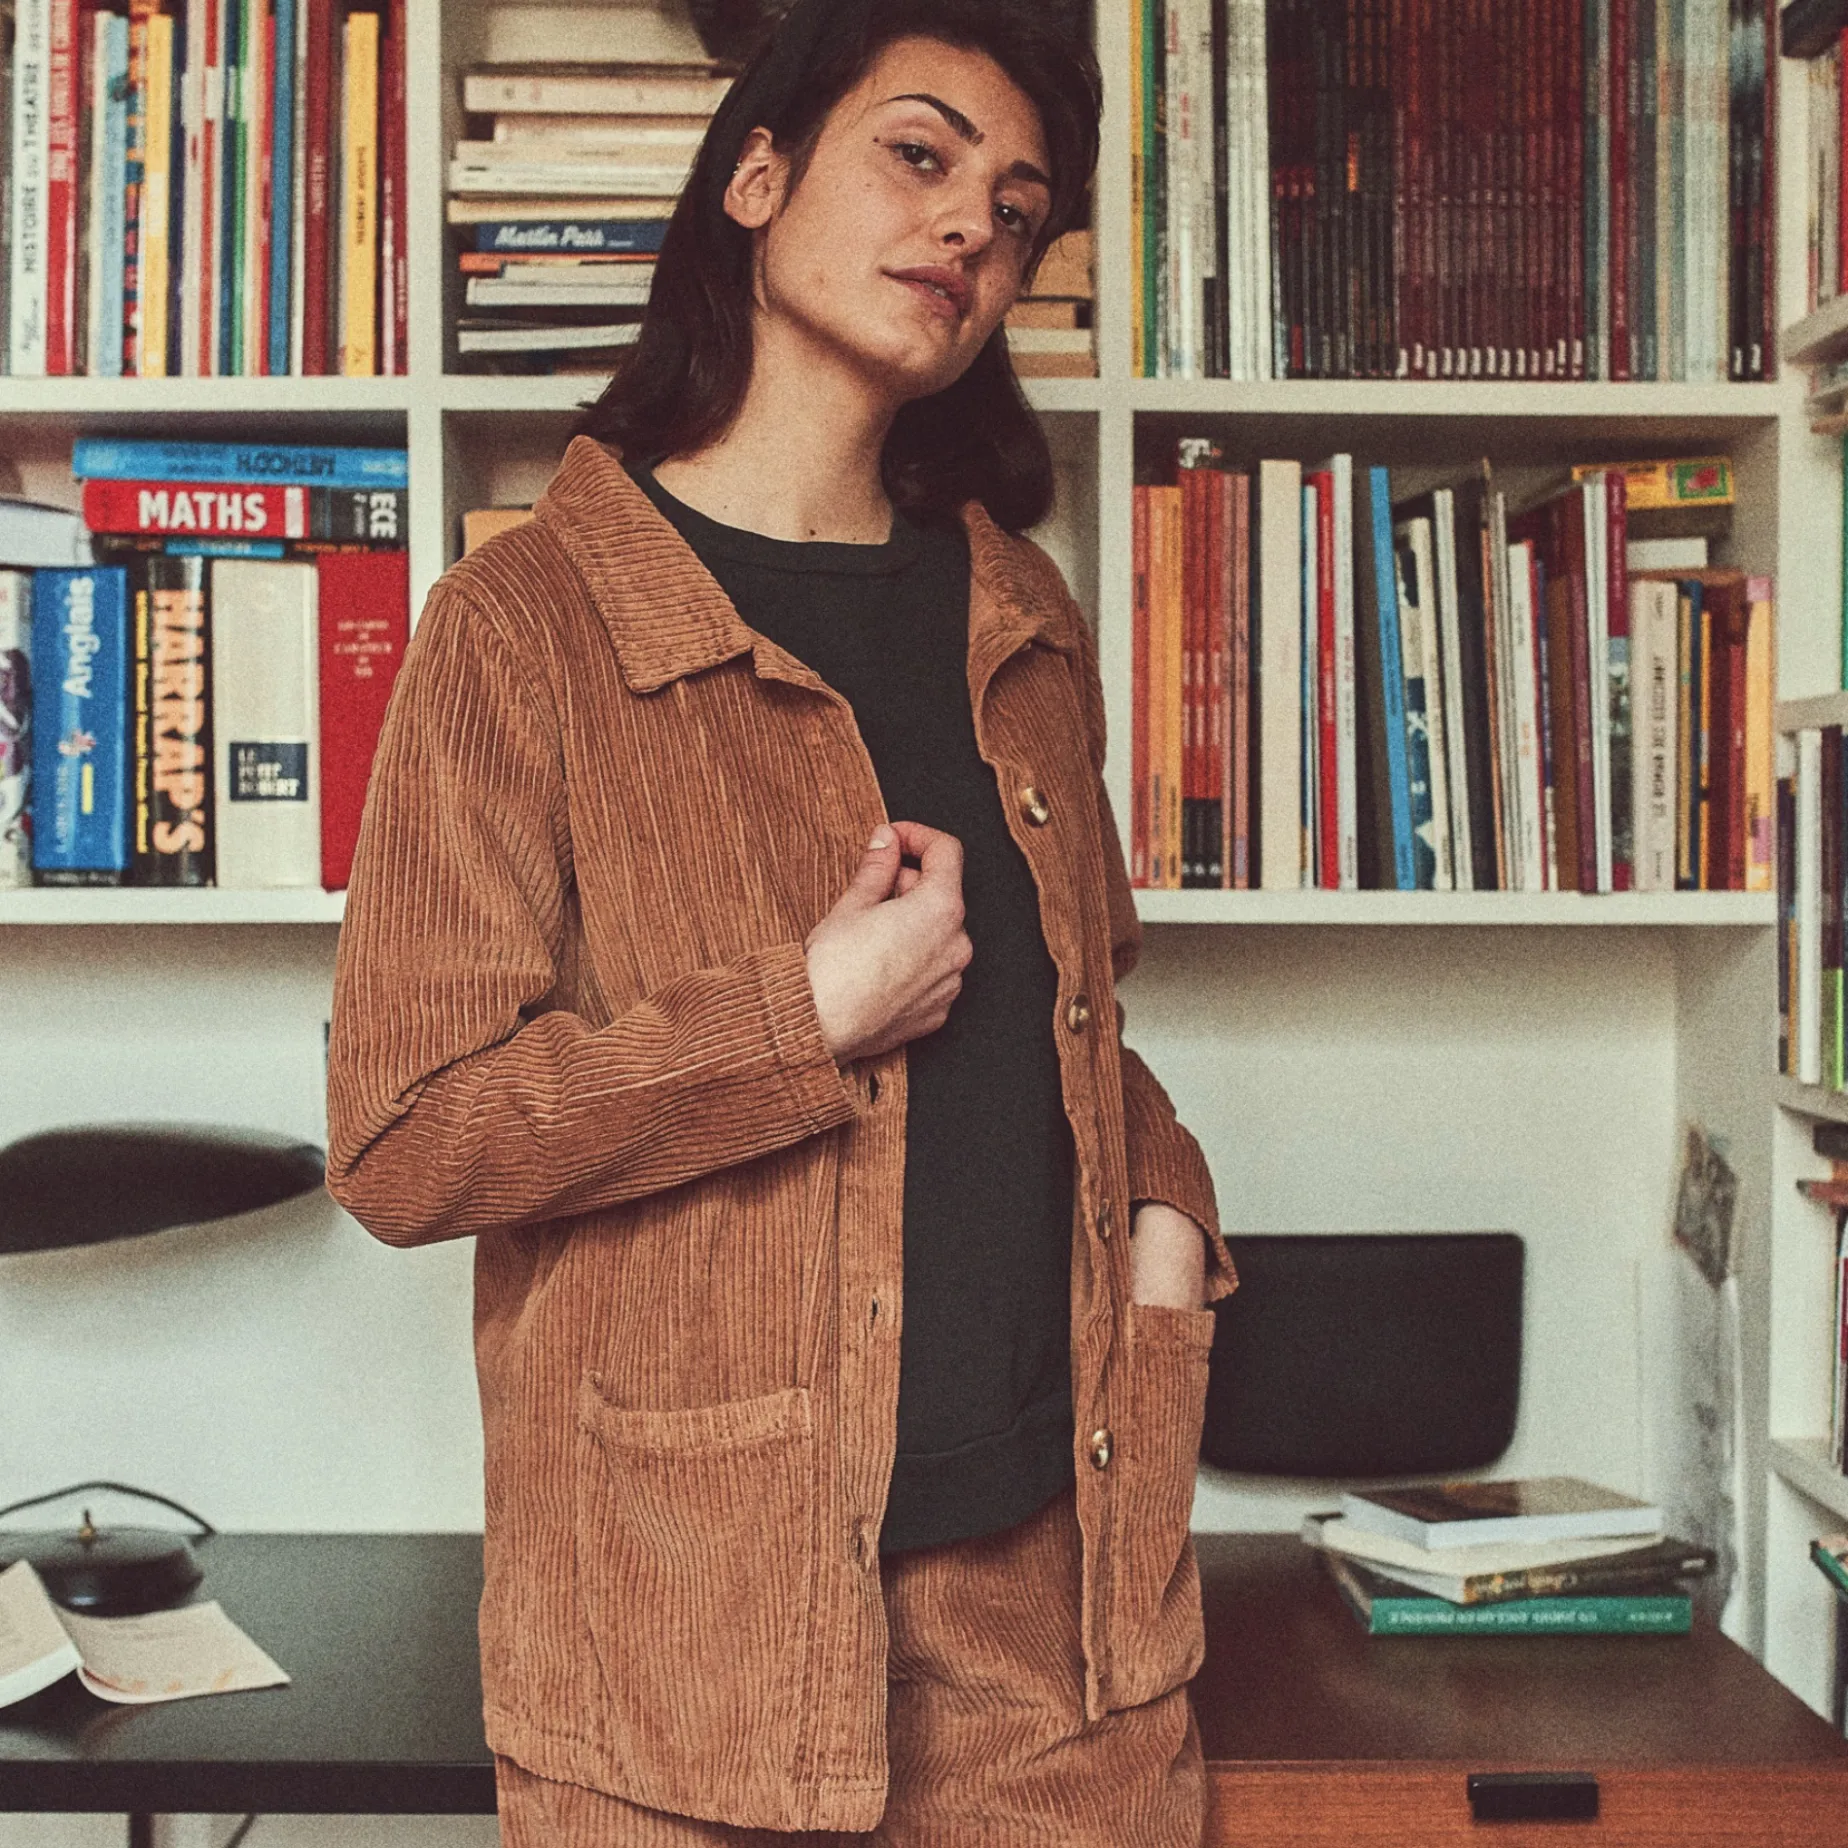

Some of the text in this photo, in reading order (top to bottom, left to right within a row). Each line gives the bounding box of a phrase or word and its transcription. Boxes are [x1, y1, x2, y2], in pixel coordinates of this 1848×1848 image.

[22, 185, 38, 274] HISTOIRE
[137, 490, 267, 531] MATHS
[370, 492, 397, 539] ECE
[63, 577, 100, 698] Anglais
[152, 589, 206, 855] HARRAP'S
